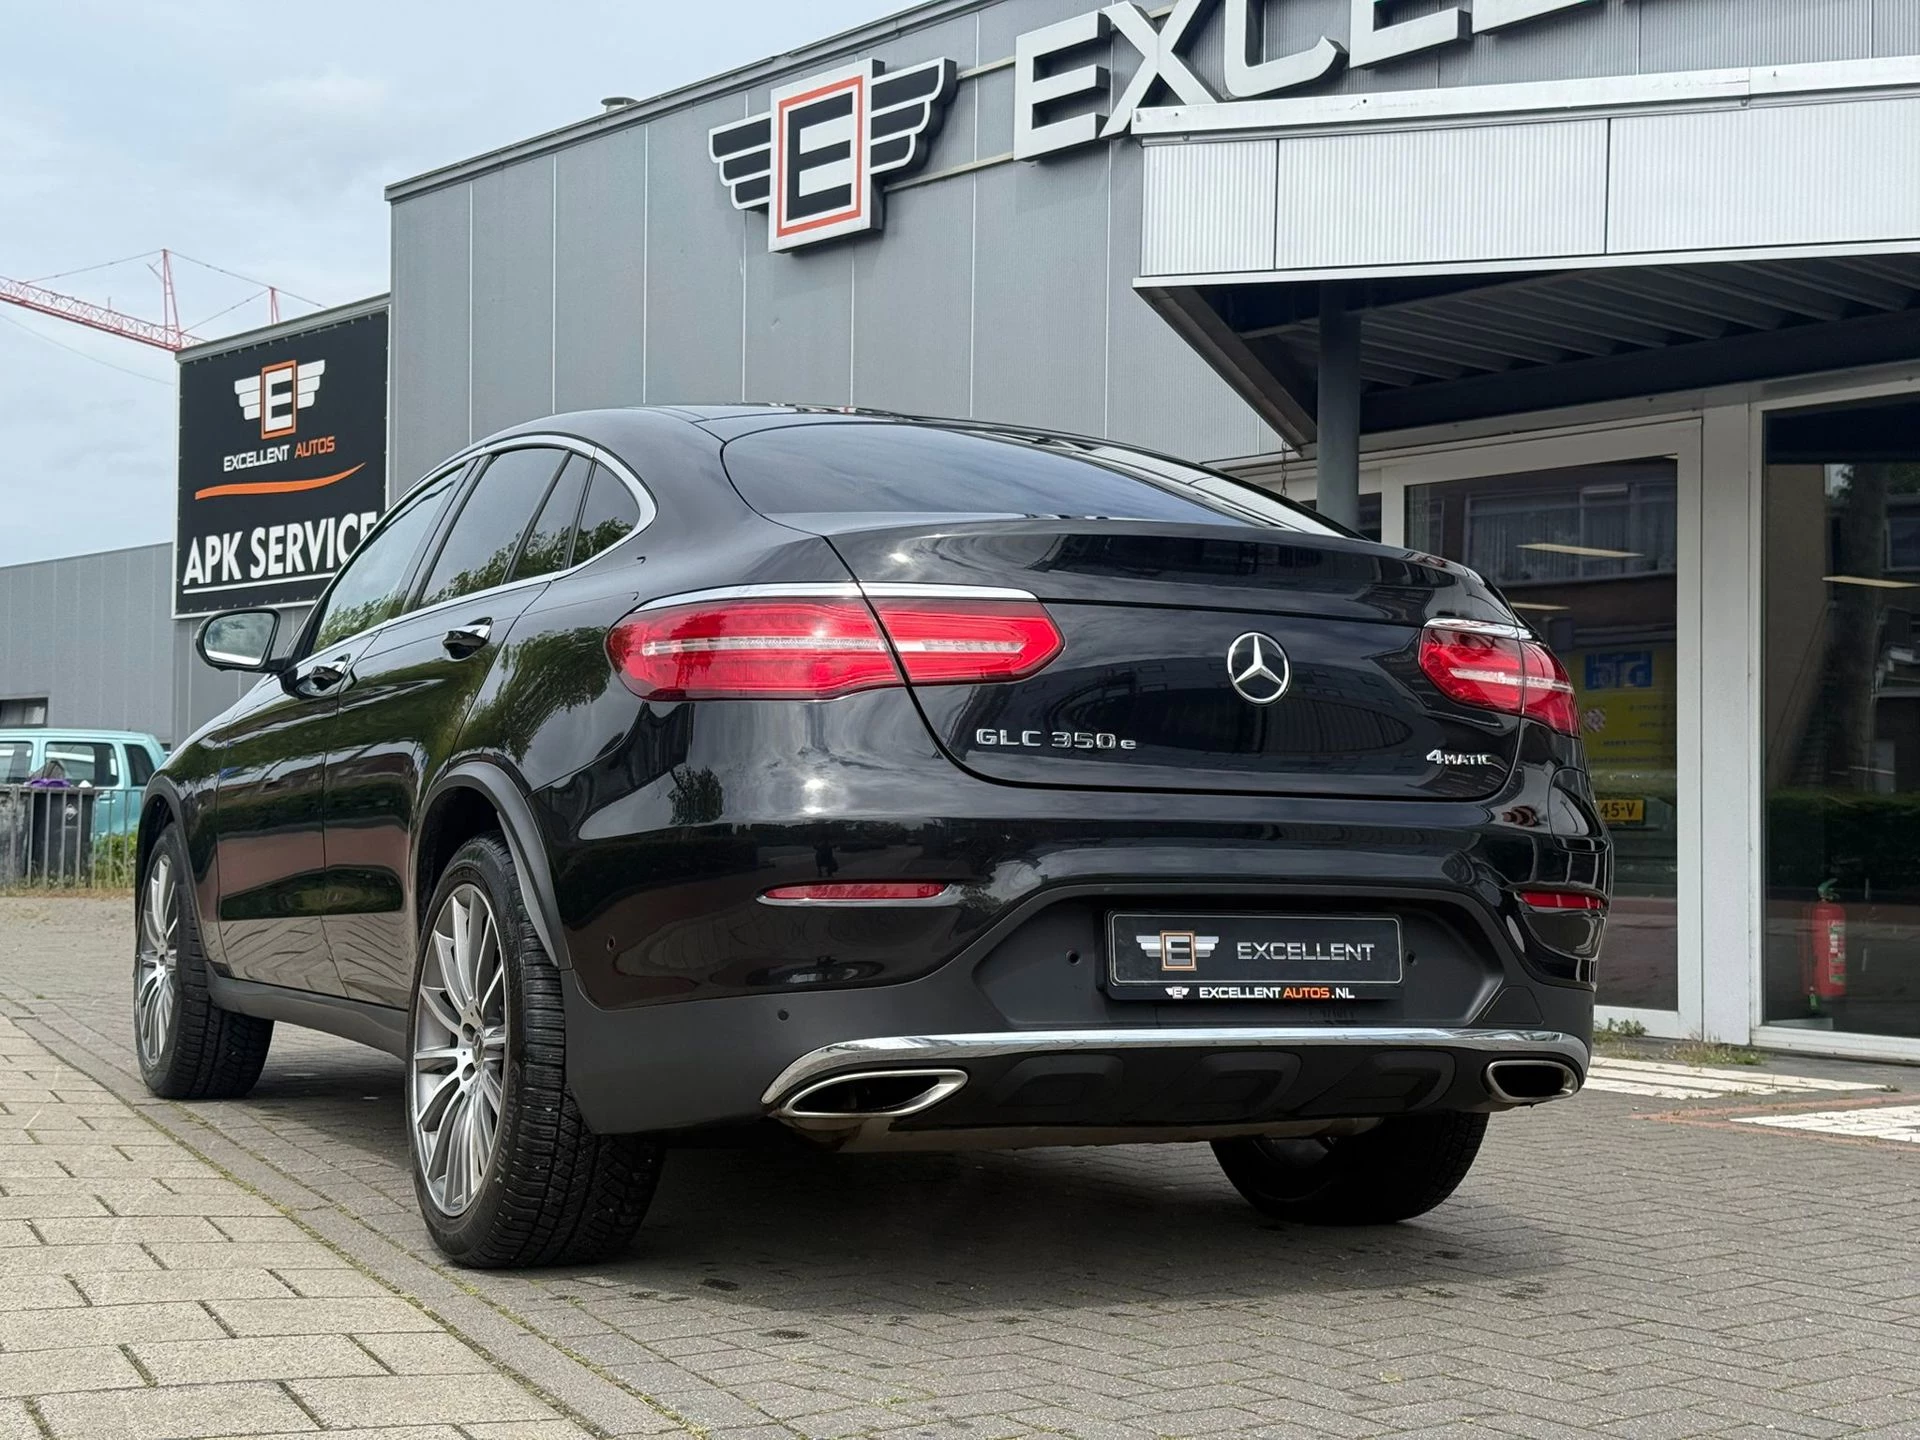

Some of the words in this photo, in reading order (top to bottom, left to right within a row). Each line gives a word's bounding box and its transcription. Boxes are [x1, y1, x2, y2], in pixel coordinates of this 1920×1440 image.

[786, 91, 853, 222] E
[264, 367, 293, 432] E
[223, 444, 290, 472] EXCELLENT
[294, 435, 336, 458] AUTOS
[182, 530, 243, 586] APK
[976, 728, 1042, 747] GLC
[1051, 731, 1137, 750] 350e
[1426, 749, 1492, 765] 4MATIC
[1166, 936, 1191, 965] E
[1236, 942, 1375, 961] EXCELLENT
